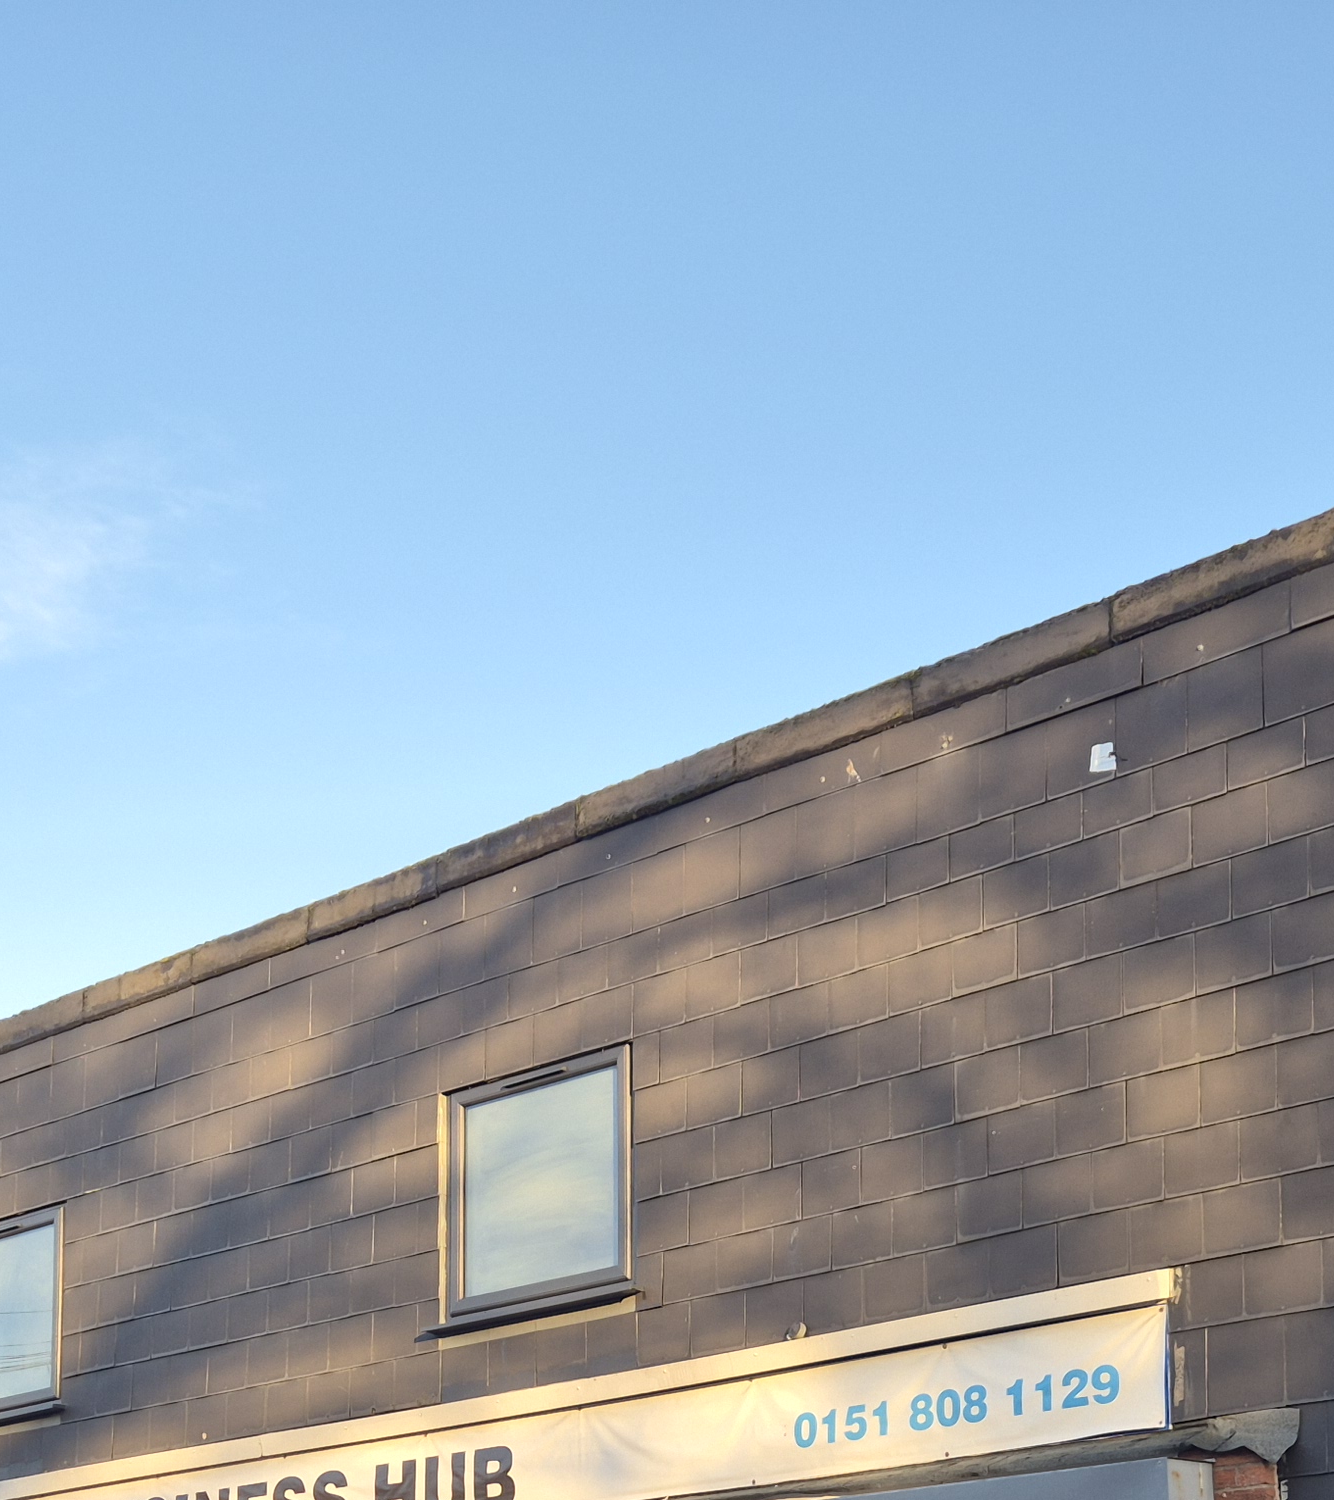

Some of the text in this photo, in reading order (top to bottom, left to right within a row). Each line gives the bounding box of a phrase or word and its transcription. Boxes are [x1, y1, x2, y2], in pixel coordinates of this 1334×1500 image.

[793, 1364, 1120, 1448] 0151 808 1129
